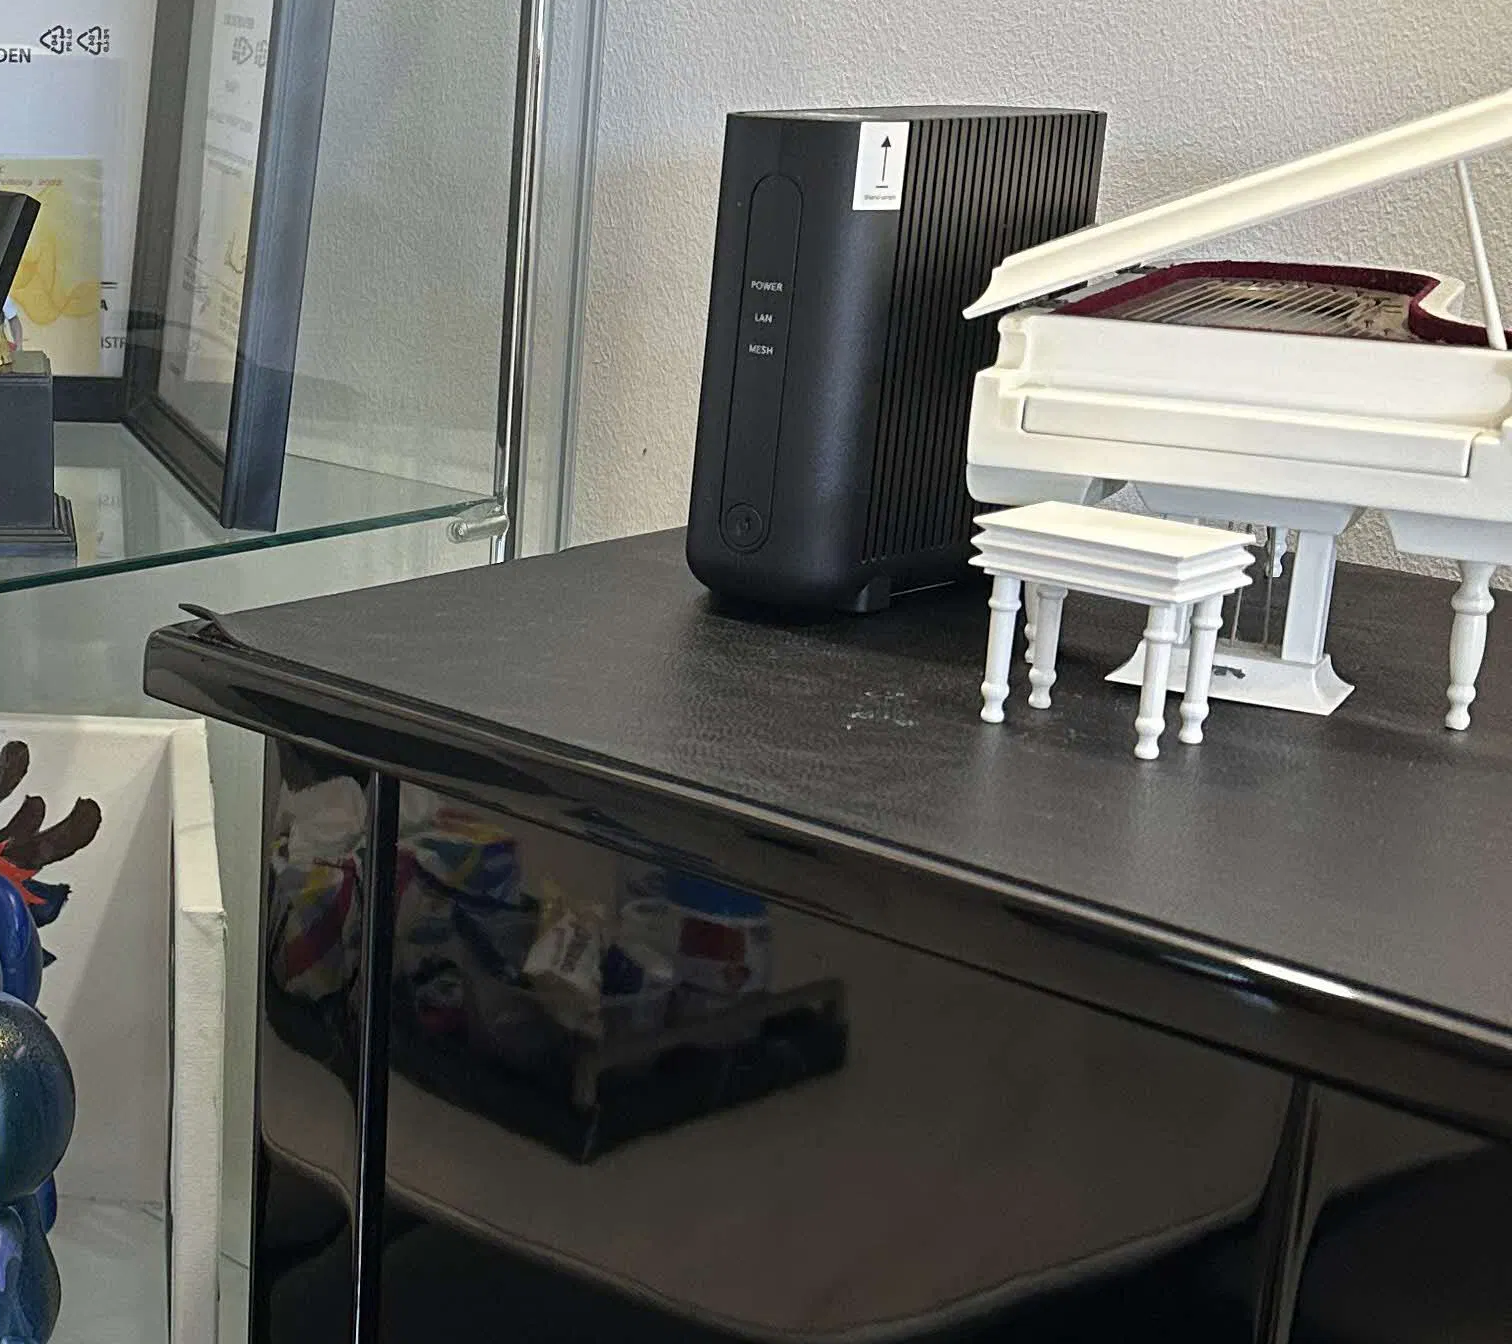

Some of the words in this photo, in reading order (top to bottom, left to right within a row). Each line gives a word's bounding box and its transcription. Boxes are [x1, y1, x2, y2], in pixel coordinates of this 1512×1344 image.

[751, 280, 783, 292] POWER
[754, 312, 773, 323] LAN
[749, 343, 774, 355] MESH
